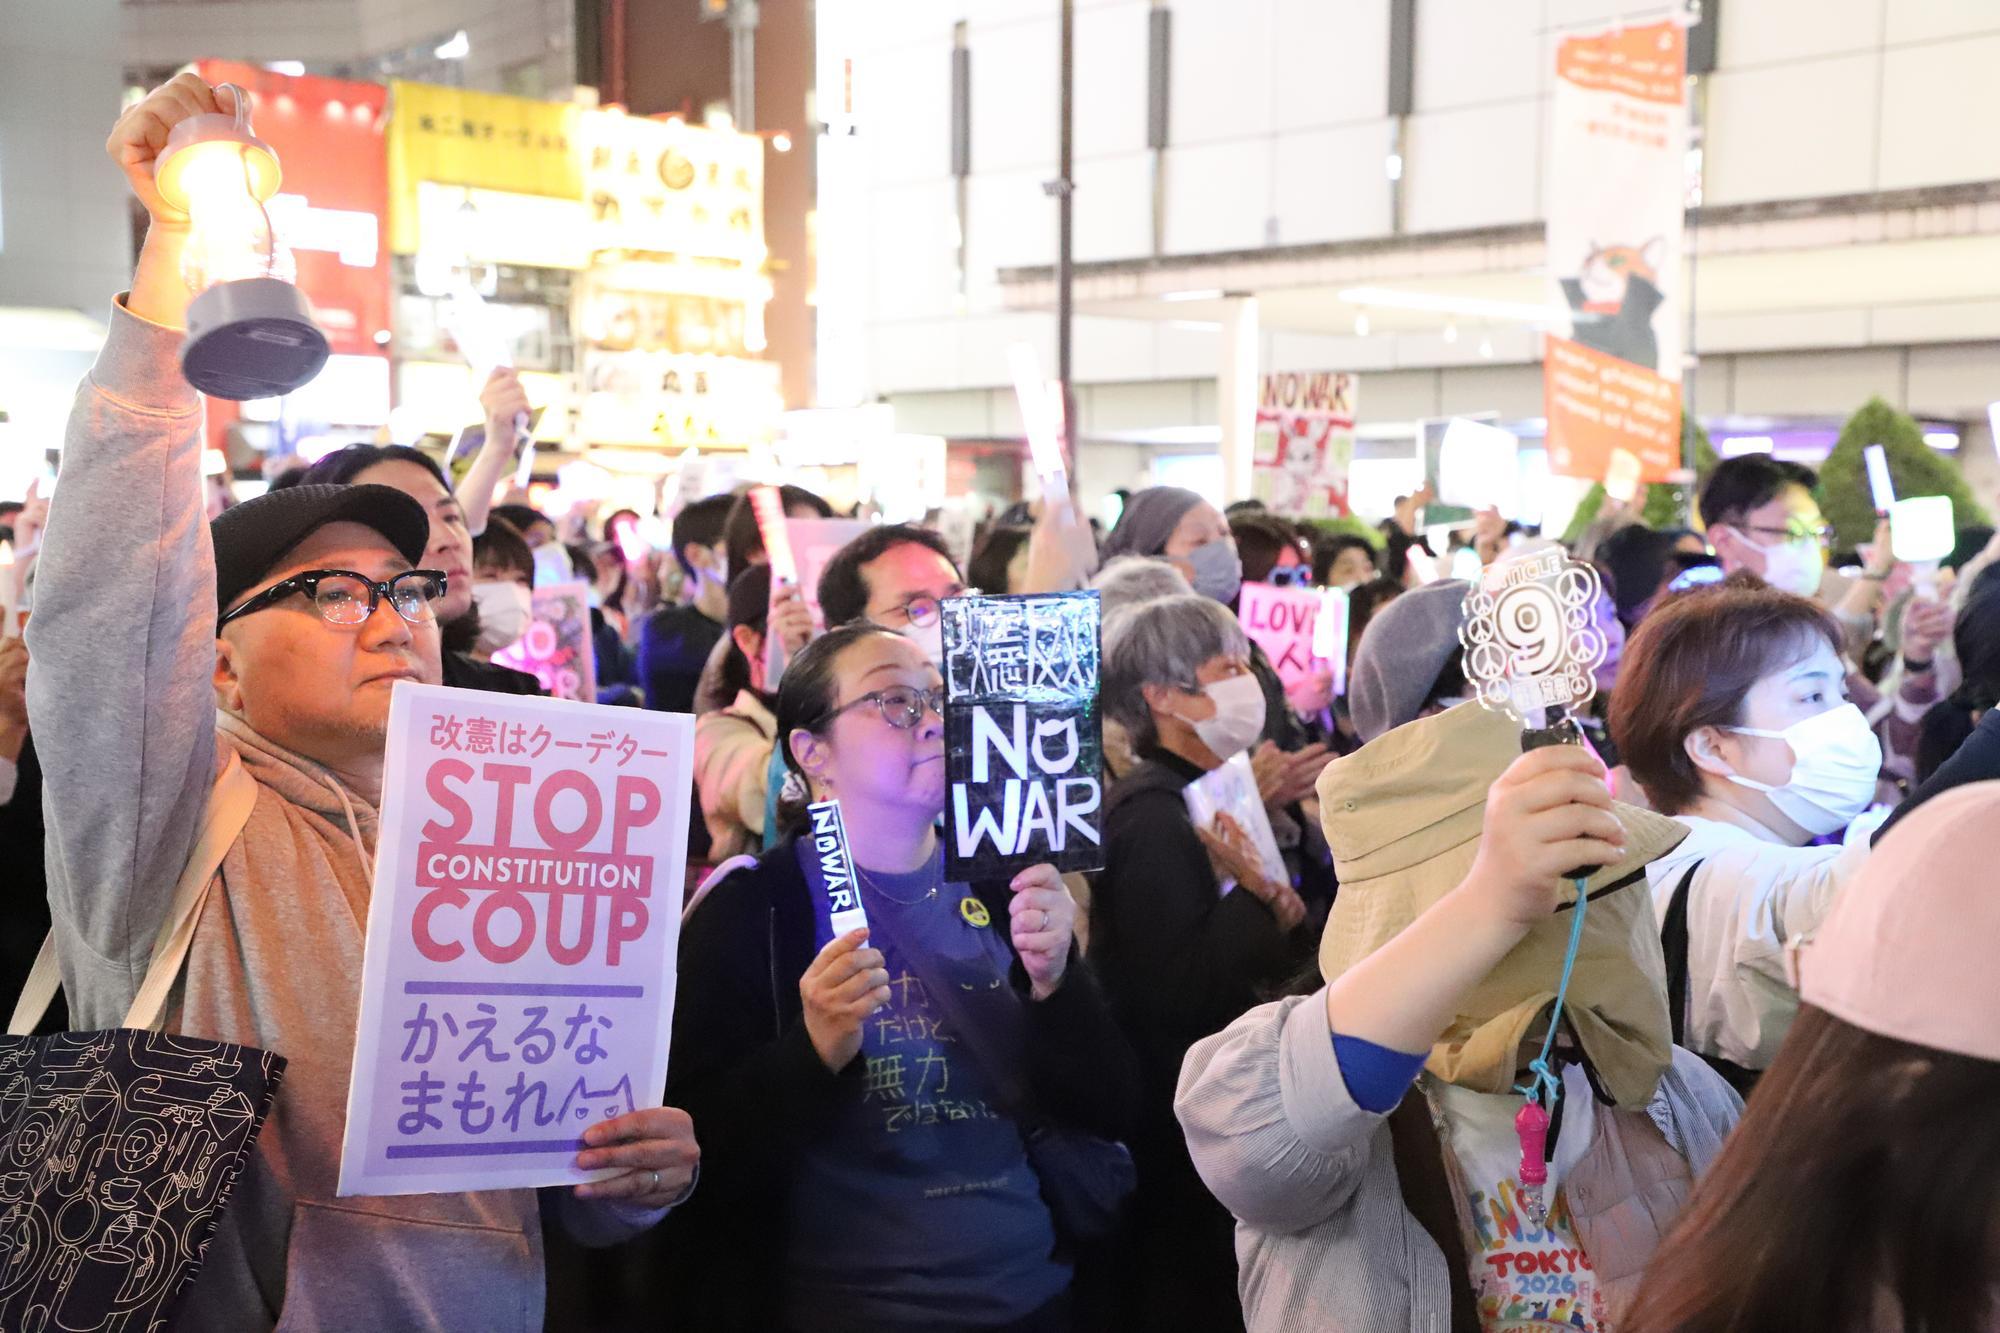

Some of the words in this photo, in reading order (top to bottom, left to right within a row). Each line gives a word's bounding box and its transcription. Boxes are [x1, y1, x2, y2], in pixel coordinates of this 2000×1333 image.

[1493, 582, 1567, 678] 9
[430, 714, 668, 767] 改憲はクーデター
[972, 704, 1080, 783] NO
[421, 758, 661, 855] STOP
[952, 777, 1101, 858] WAR
[427, 853, 641, 890] CONSTITUTION
[411, 887, 649, 966] COUP
[400, 1002, 613, 1065] かえるな
[397, 1070, 555, 1135] まもれ
[863, 1047, 949, 1103] 無力
[1515, 1274, 1577, 1295] 2026
